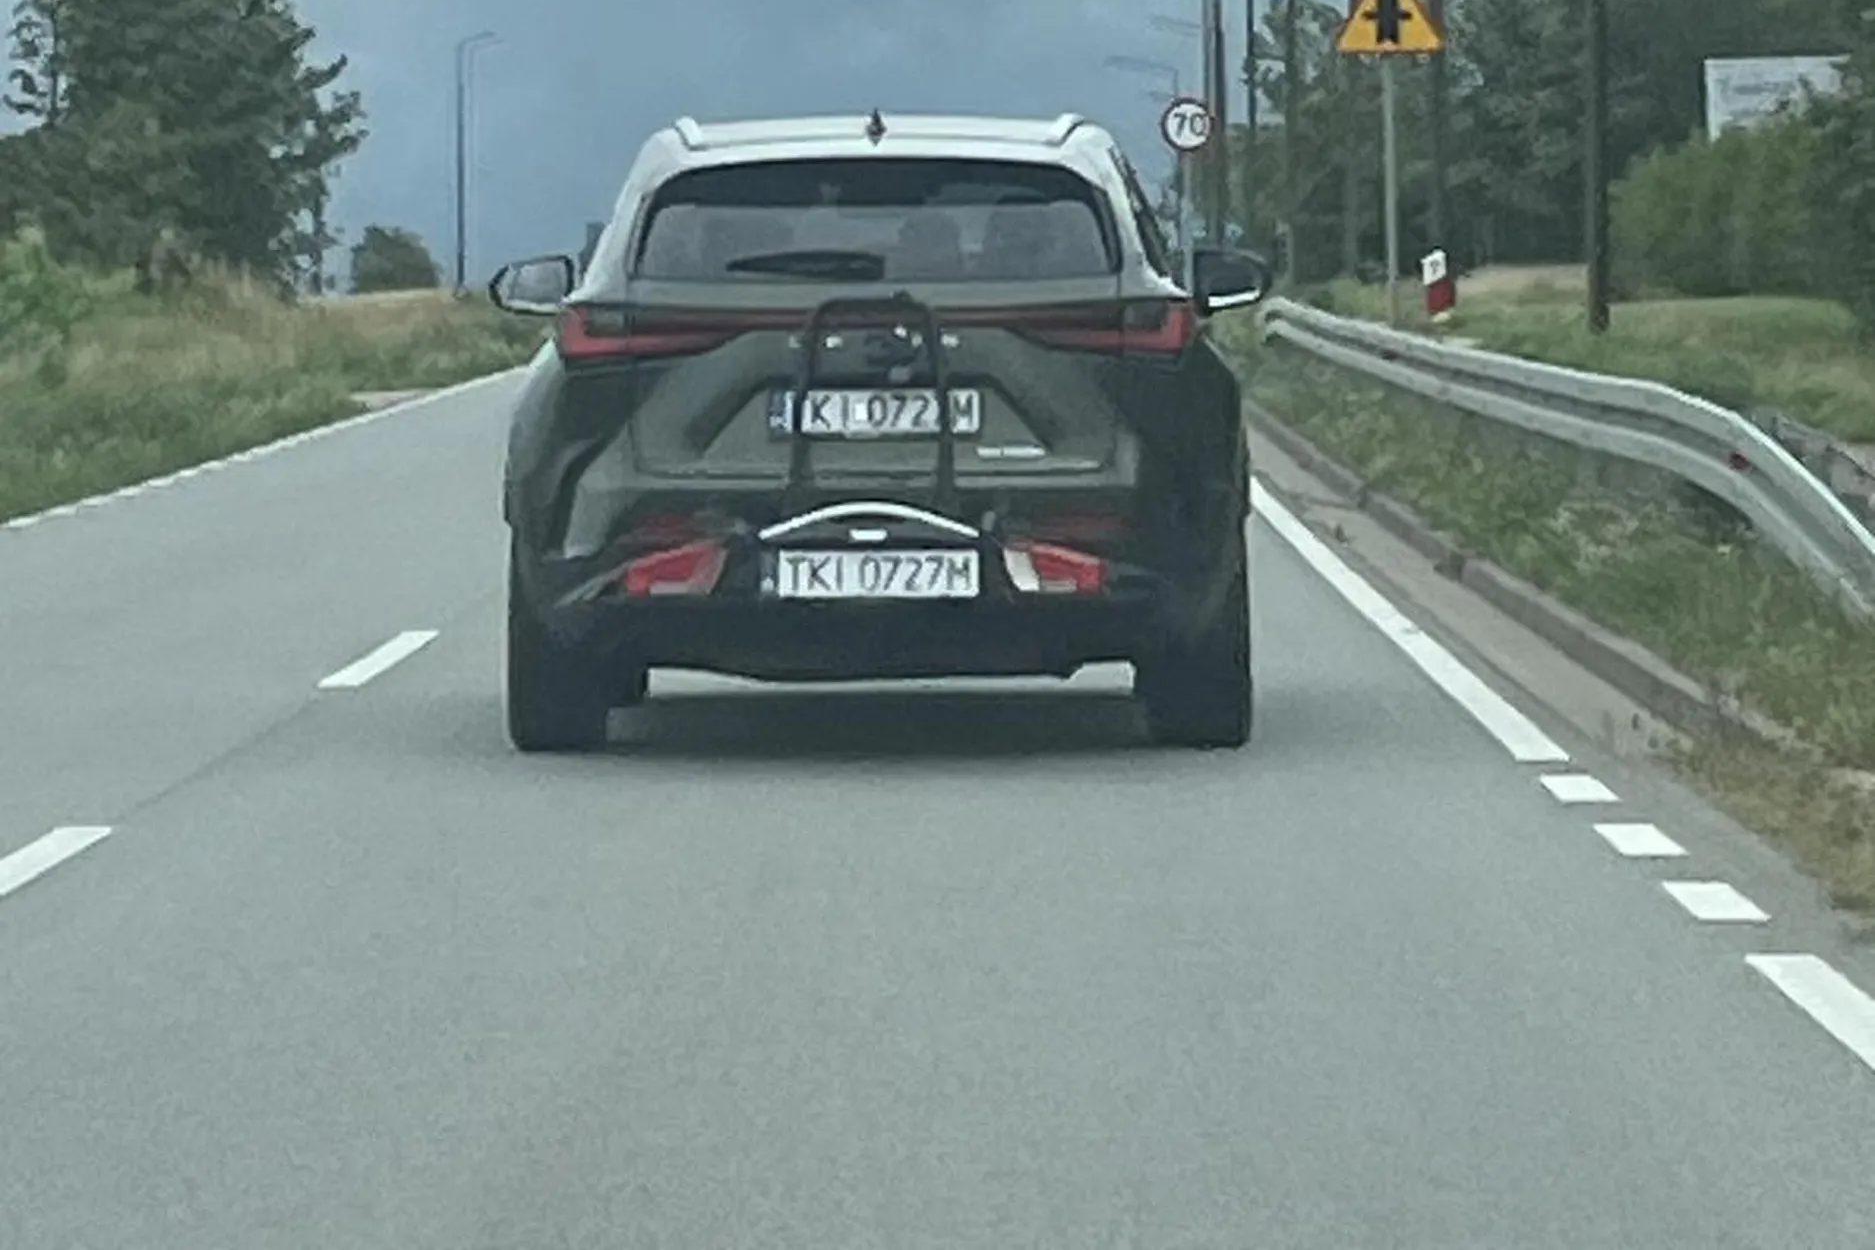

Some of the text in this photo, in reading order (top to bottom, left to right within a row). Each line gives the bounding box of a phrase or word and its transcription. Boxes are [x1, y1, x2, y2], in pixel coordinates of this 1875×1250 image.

[1173, 112, 1206, 138] 70
[793, 394, 850, 430] KI
[867, 393, 974, 430] 072M
[785, 555, 845, 592] TKI
[859, 554, 973, 592] 0727M
